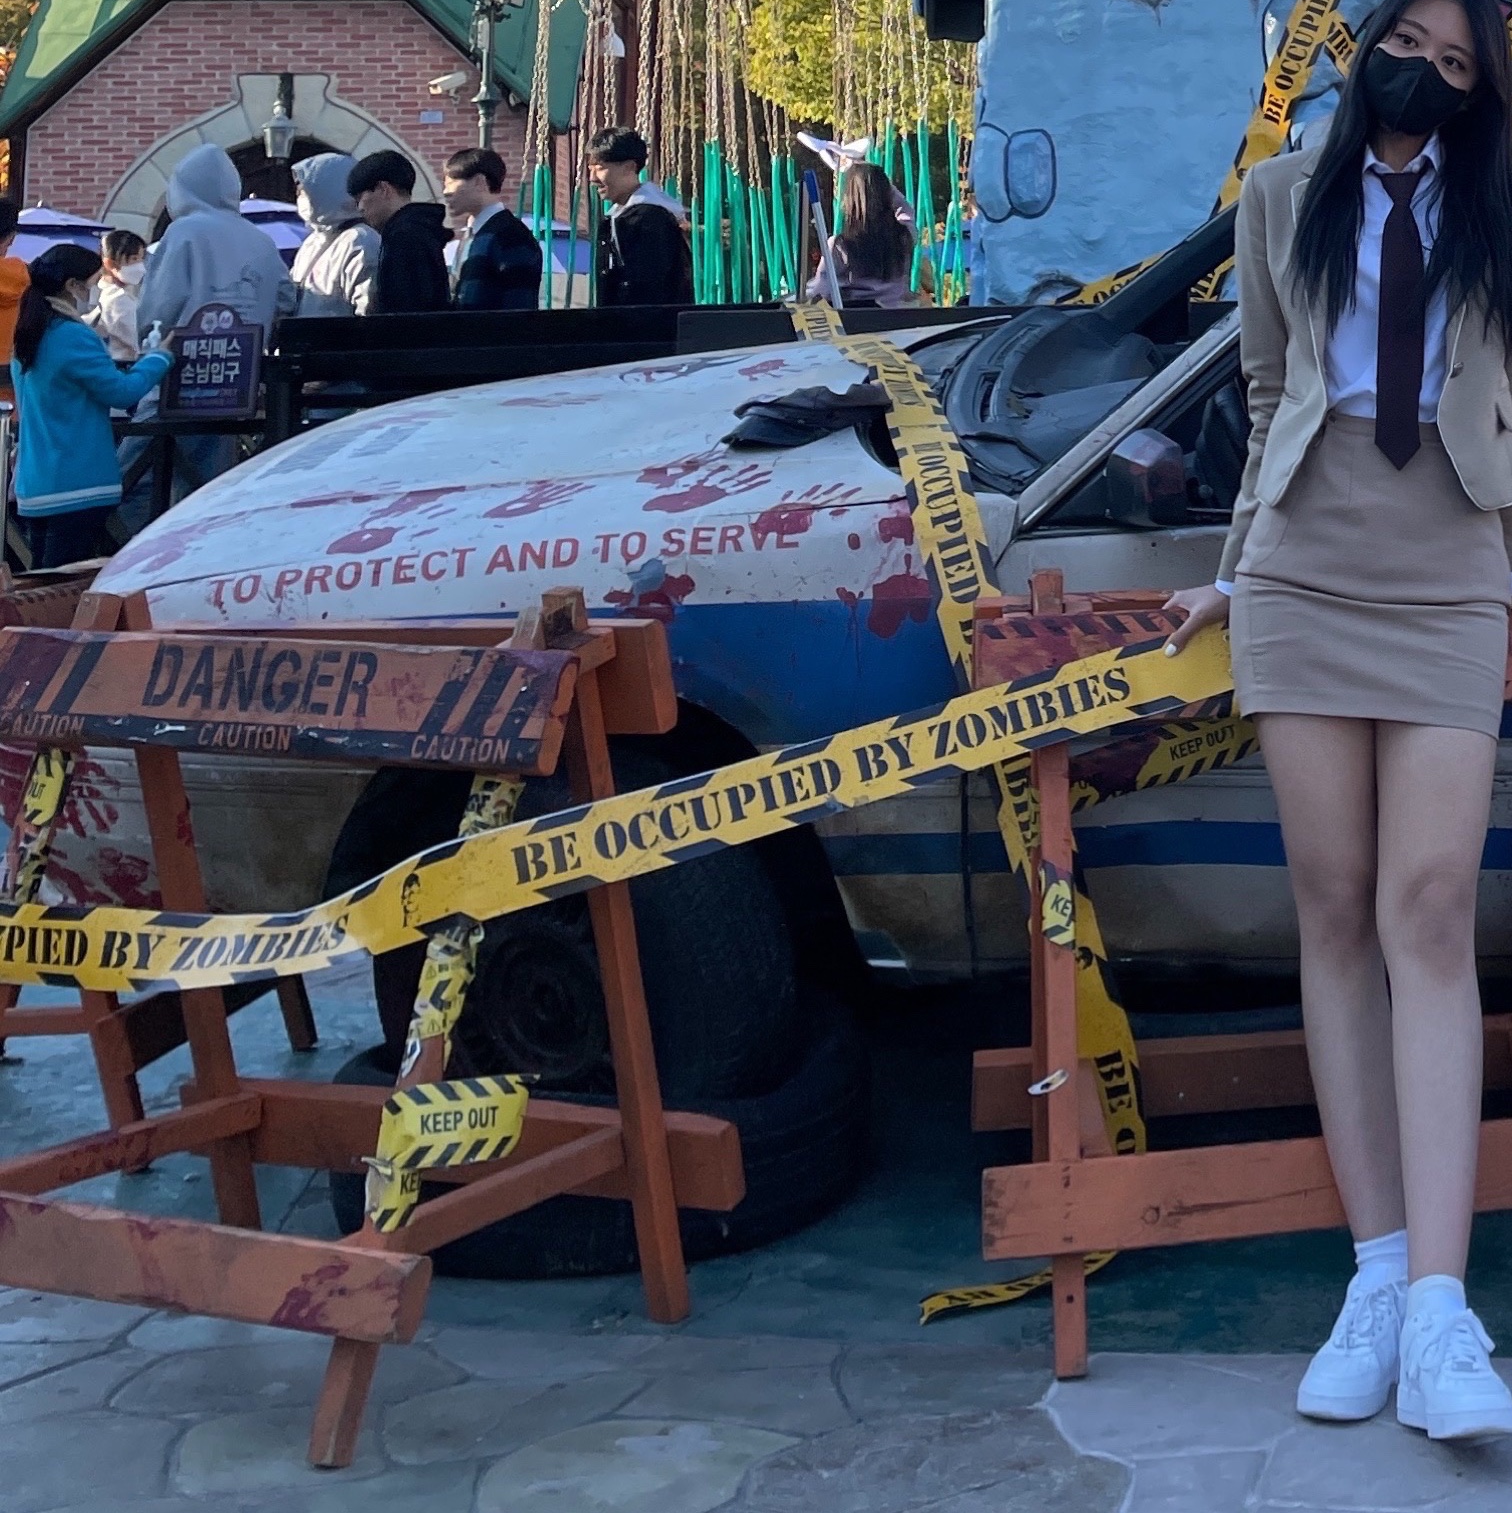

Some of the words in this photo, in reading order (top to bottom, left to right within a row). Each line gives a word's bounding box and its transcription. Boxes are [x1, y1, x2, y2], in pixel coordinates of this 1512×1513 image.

[1264, 94, 1287, 126] BE
[180, 361, 240, 385] 손님입구
[182, 338, 241, 359] 매직패스
[917, 455, 981, 605] OCCUPIED
[209, 572, 261, 609] TO
[275, 547, 476, 597] PROTECT
[485, 537, 579, 576] AND
[594, 530, 647, 564] TO
[142, 639, 378, 719] DANGER
[0, 710, 86, 738] CAUTION
[197, 721, 291, 753] CAUTION
[410, 733, 511, 765] CAUTION
[1169, 735, 1204, 761] KEEP
[1207, 723, 1236, 748] OUT
[511, 829, 583, 885] BE
[593, 755, 843, 862] OCCUPIED
[856, 731, 918, 782] BY
[927, 665, 1133, 758] ZOMBIES
[99, 930, 166, 971] BY
[170, 914, 349, 971] ZOMBIES
[1094, 1049, 1133, 1115] BE
[420, 1111, 463, 1136] KEEP
[468, 1105, 499, 1129] OUT
